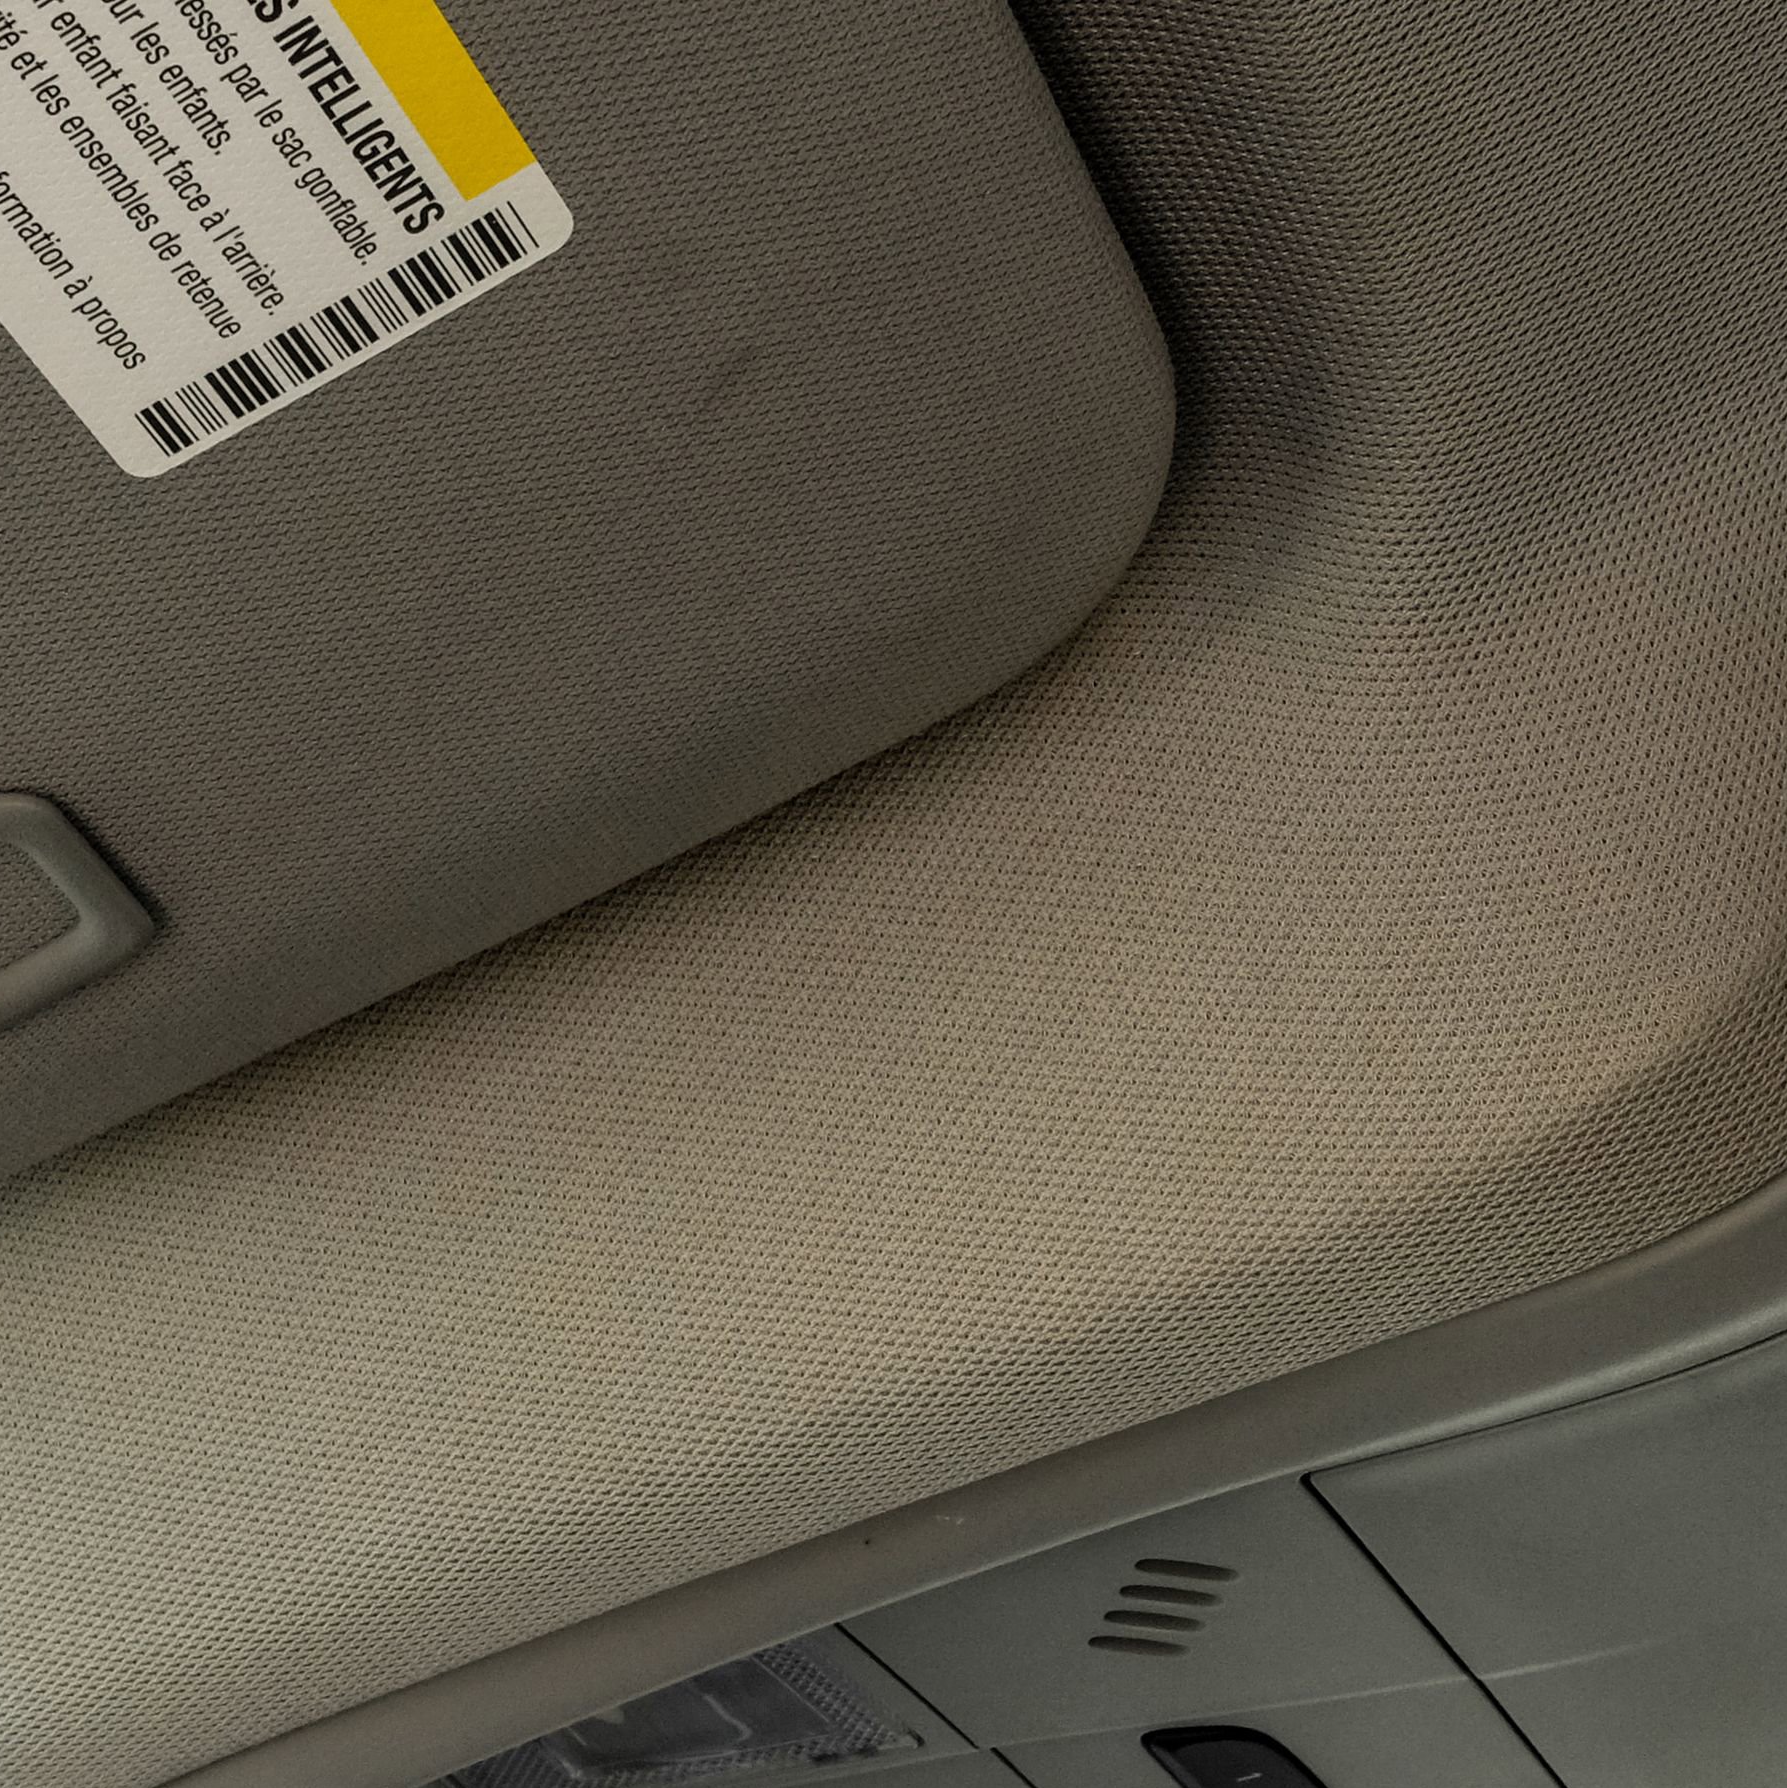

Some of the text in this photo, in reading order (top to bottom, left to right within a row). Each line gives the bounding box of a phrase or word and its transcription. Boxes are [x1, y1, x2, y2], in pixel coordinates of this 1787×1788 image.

[50, 11, 123, 89] enfant
[101, 0, 231, 156] ur les enfants.
[106, 82, 180, 165] faisant
[273, 15, 445, 235] INTELLIGENTS
[10, 51, 48, 80] et
[30, 74, 70, 116] les
[59, 115, 159, 232] ensembles
[148, 230, 182, 261] de
[171, 260, 241, 338] retenue
[163, 159, 210, 212] face
[220, 63, 269, 103] par
[254, 99, 284, 128] le
[272, 127, 312, 168] sac
[295, 167, 377, 266] gonflable.
[199, 208, 229, 232] à
[63, 275, 93, 299] à
[213, 225, 284, 316] l'arrière.
[71, 296, 146, 369] propos
[1236, 1772, 1262, 1782] 1
